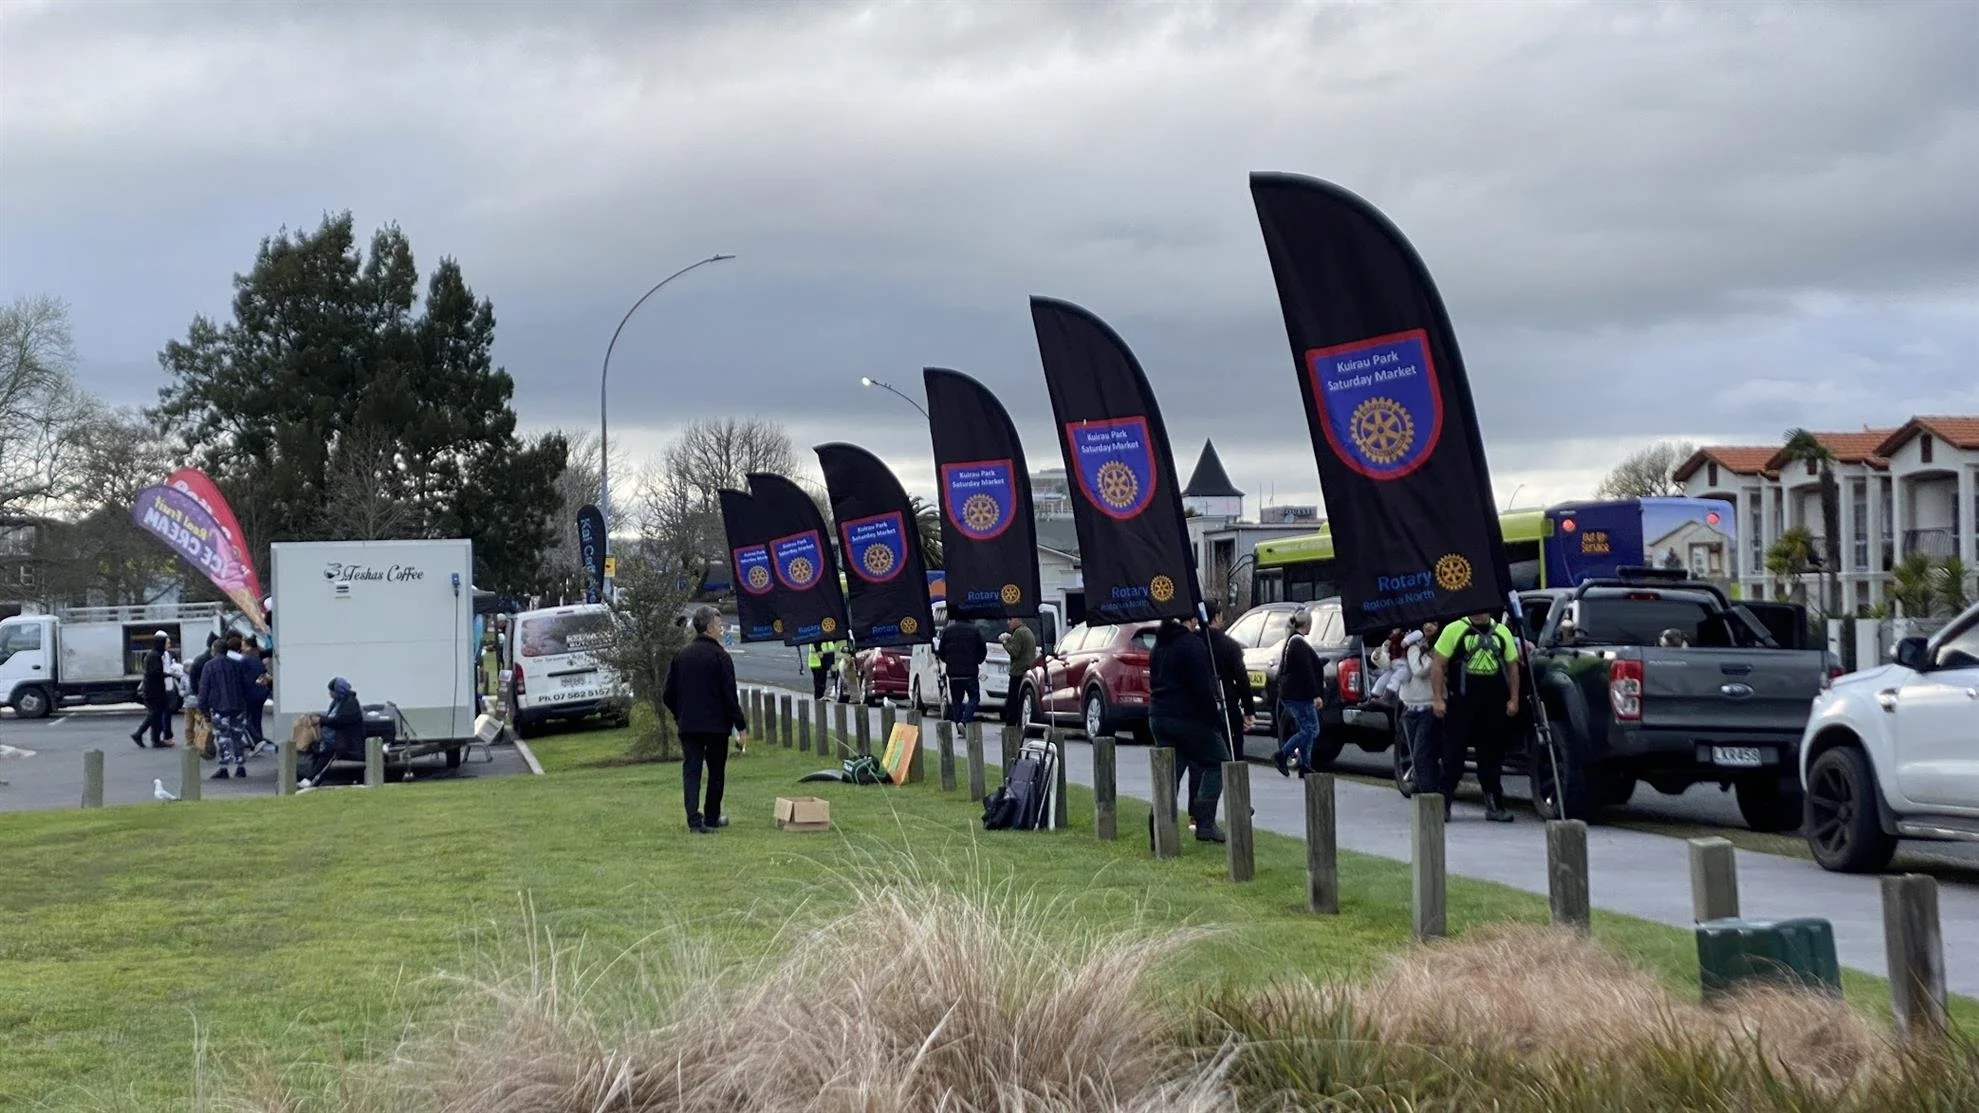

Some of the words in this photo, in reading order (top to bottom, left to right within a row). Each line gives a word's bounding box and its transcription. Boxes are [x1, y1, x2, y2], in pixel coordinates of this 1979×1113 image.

[1336, 358, 1371, 373] Kuirau
[1373, 351, 1399, 366] Park
[1327, 374, 1372, 391] Saturday
[1375, 364, 1417, 382] Market
[1087, 432, 1110, 441] Kuirau
[1111, 430, 1127, 439] Park
[1081, 444, 1111, 454] Saturday
[1112, 440, 1139, 450] Market
[387, 564, 424, 582] Coffee
[1377, 570, 1432, 592] Rotary
[1112, 586, 1149, 598] Rotary
